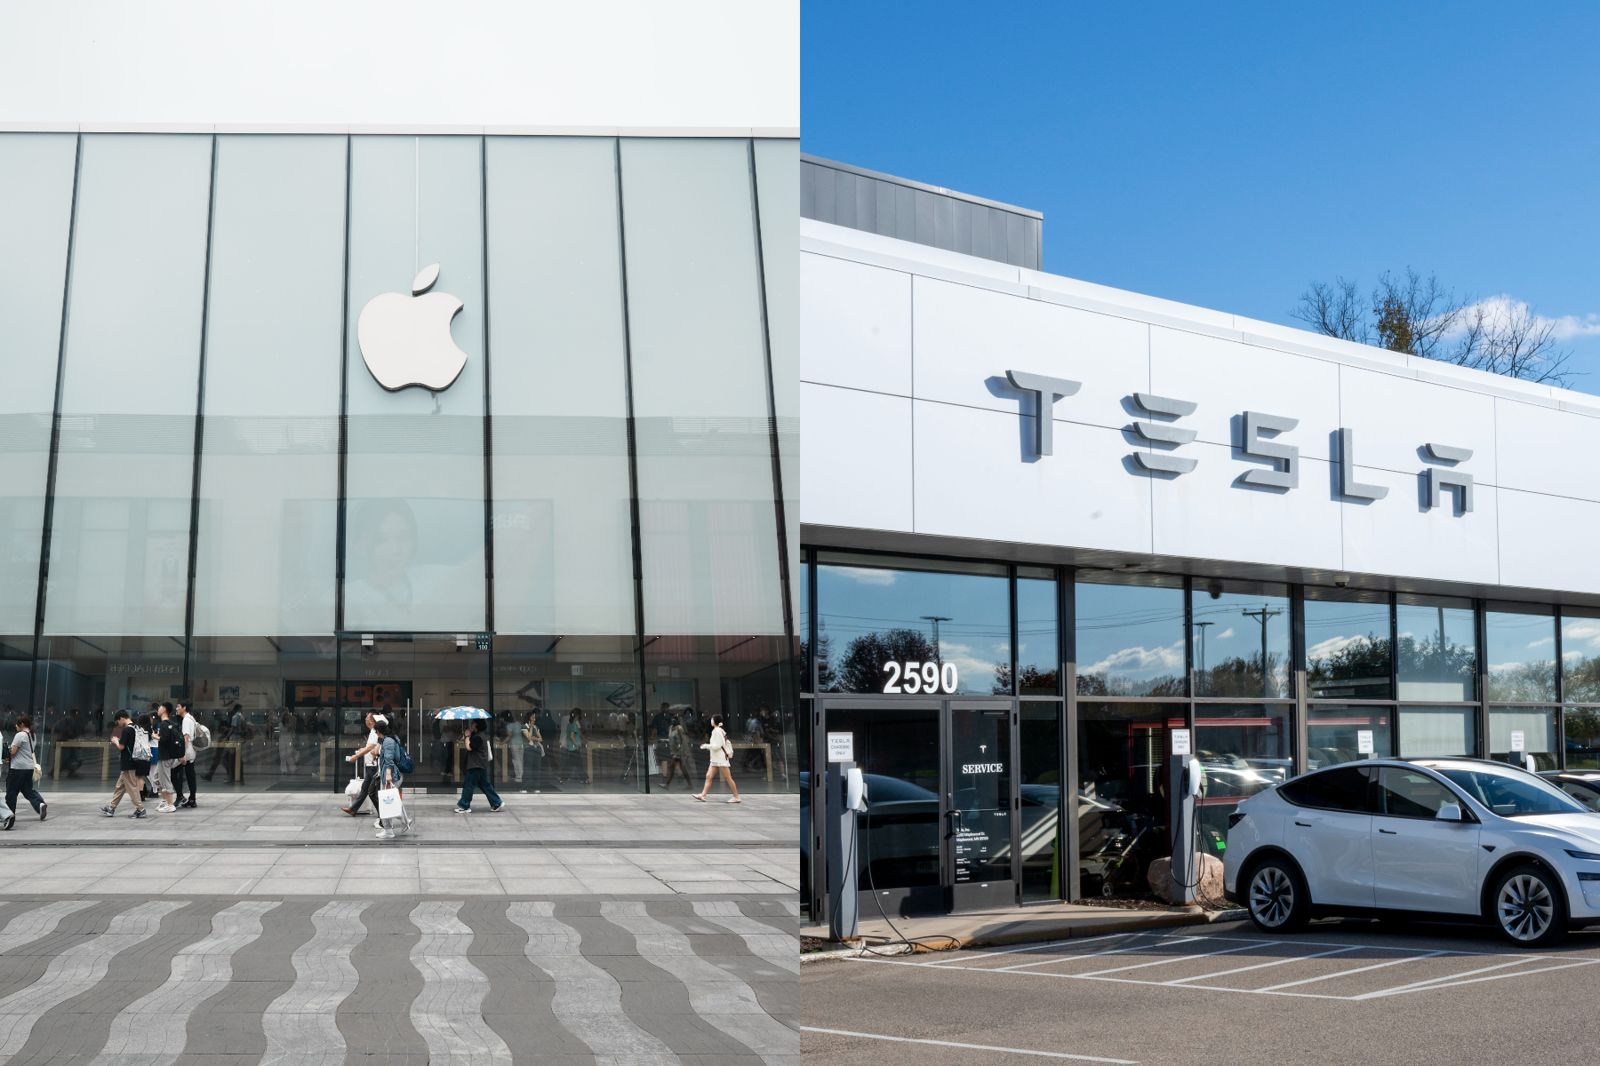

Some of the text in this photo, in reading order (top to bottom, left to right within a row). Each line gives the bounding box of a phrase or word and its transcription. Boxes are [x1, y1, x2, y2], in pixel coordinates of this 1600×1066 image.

[1005, 369, 1474, 513] TESLA
[882, 661, 958, 694] 2590
[962, 763, 1003, 774] SERVICE
